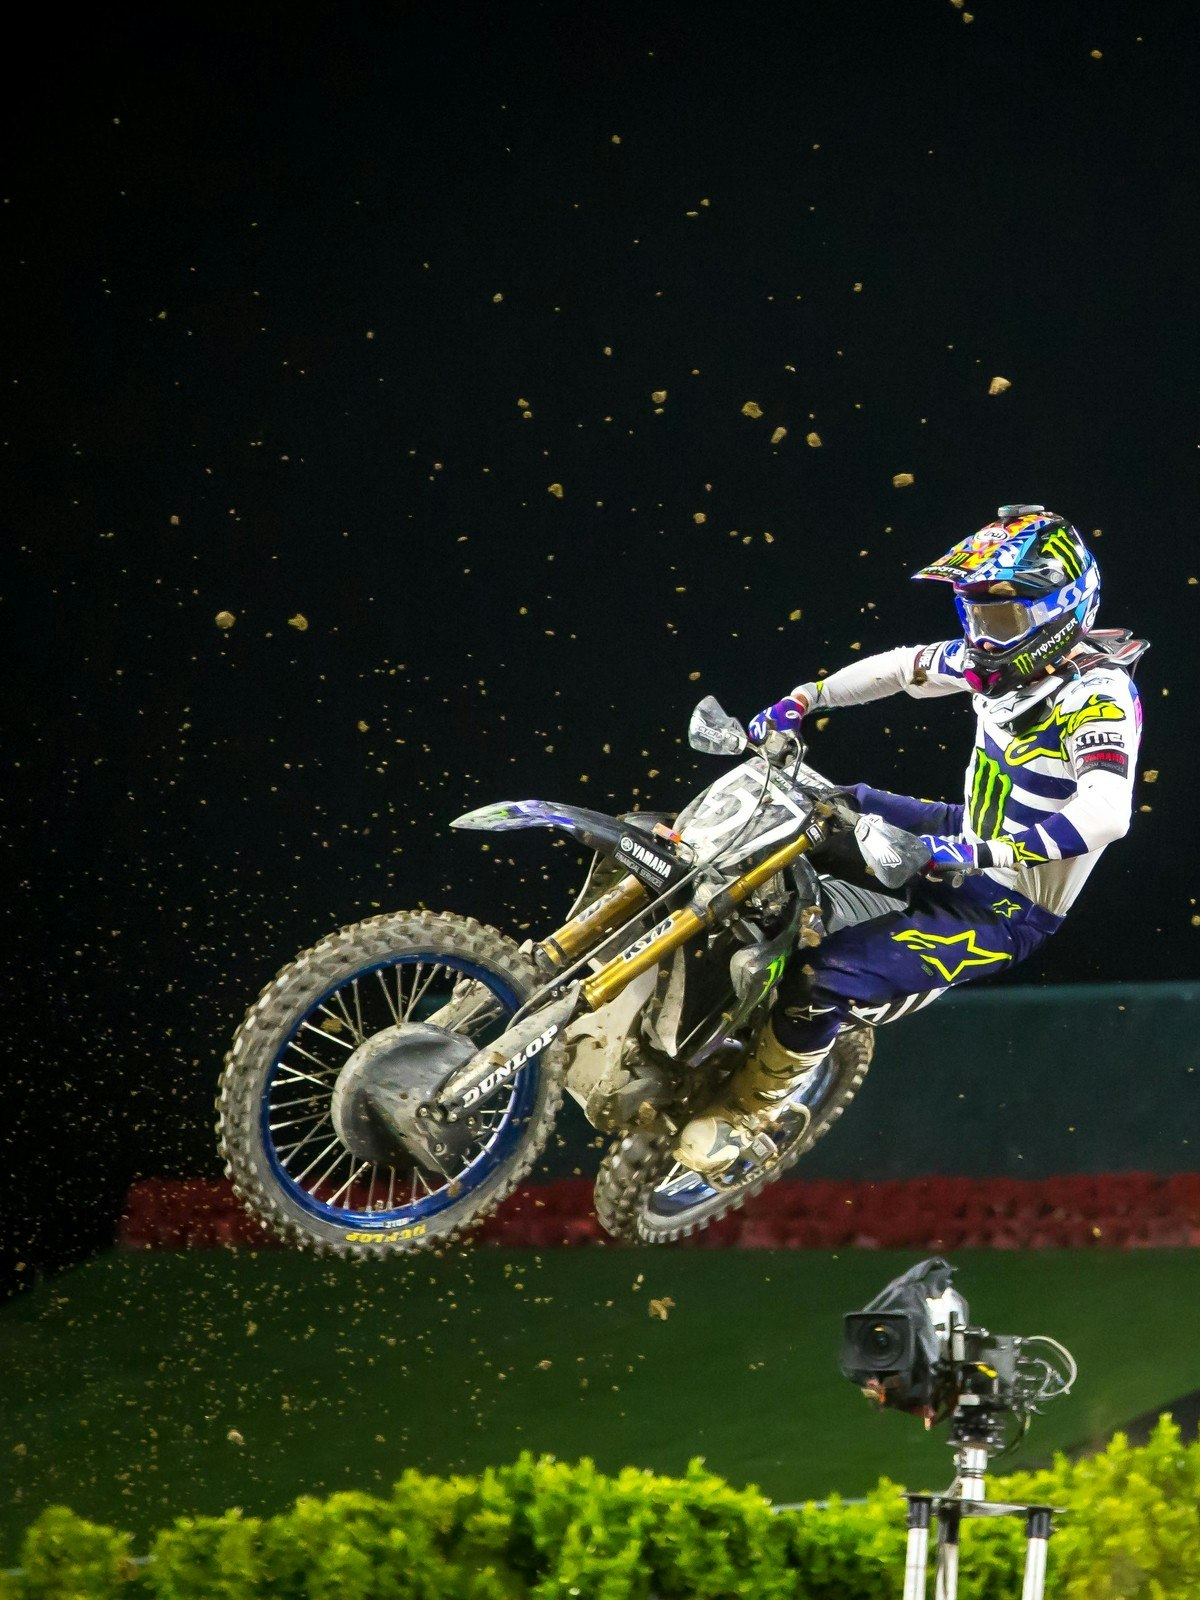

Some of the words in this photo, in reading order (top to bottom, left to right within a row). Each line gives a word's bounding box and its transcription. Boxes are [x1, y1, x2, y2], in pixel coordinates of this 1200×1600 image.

[1030, 617, 1079, 660] MONSTER
[631, 842, 672, 878] YAMAHA
[462, 1023, 558, 1108] DUNLOP
